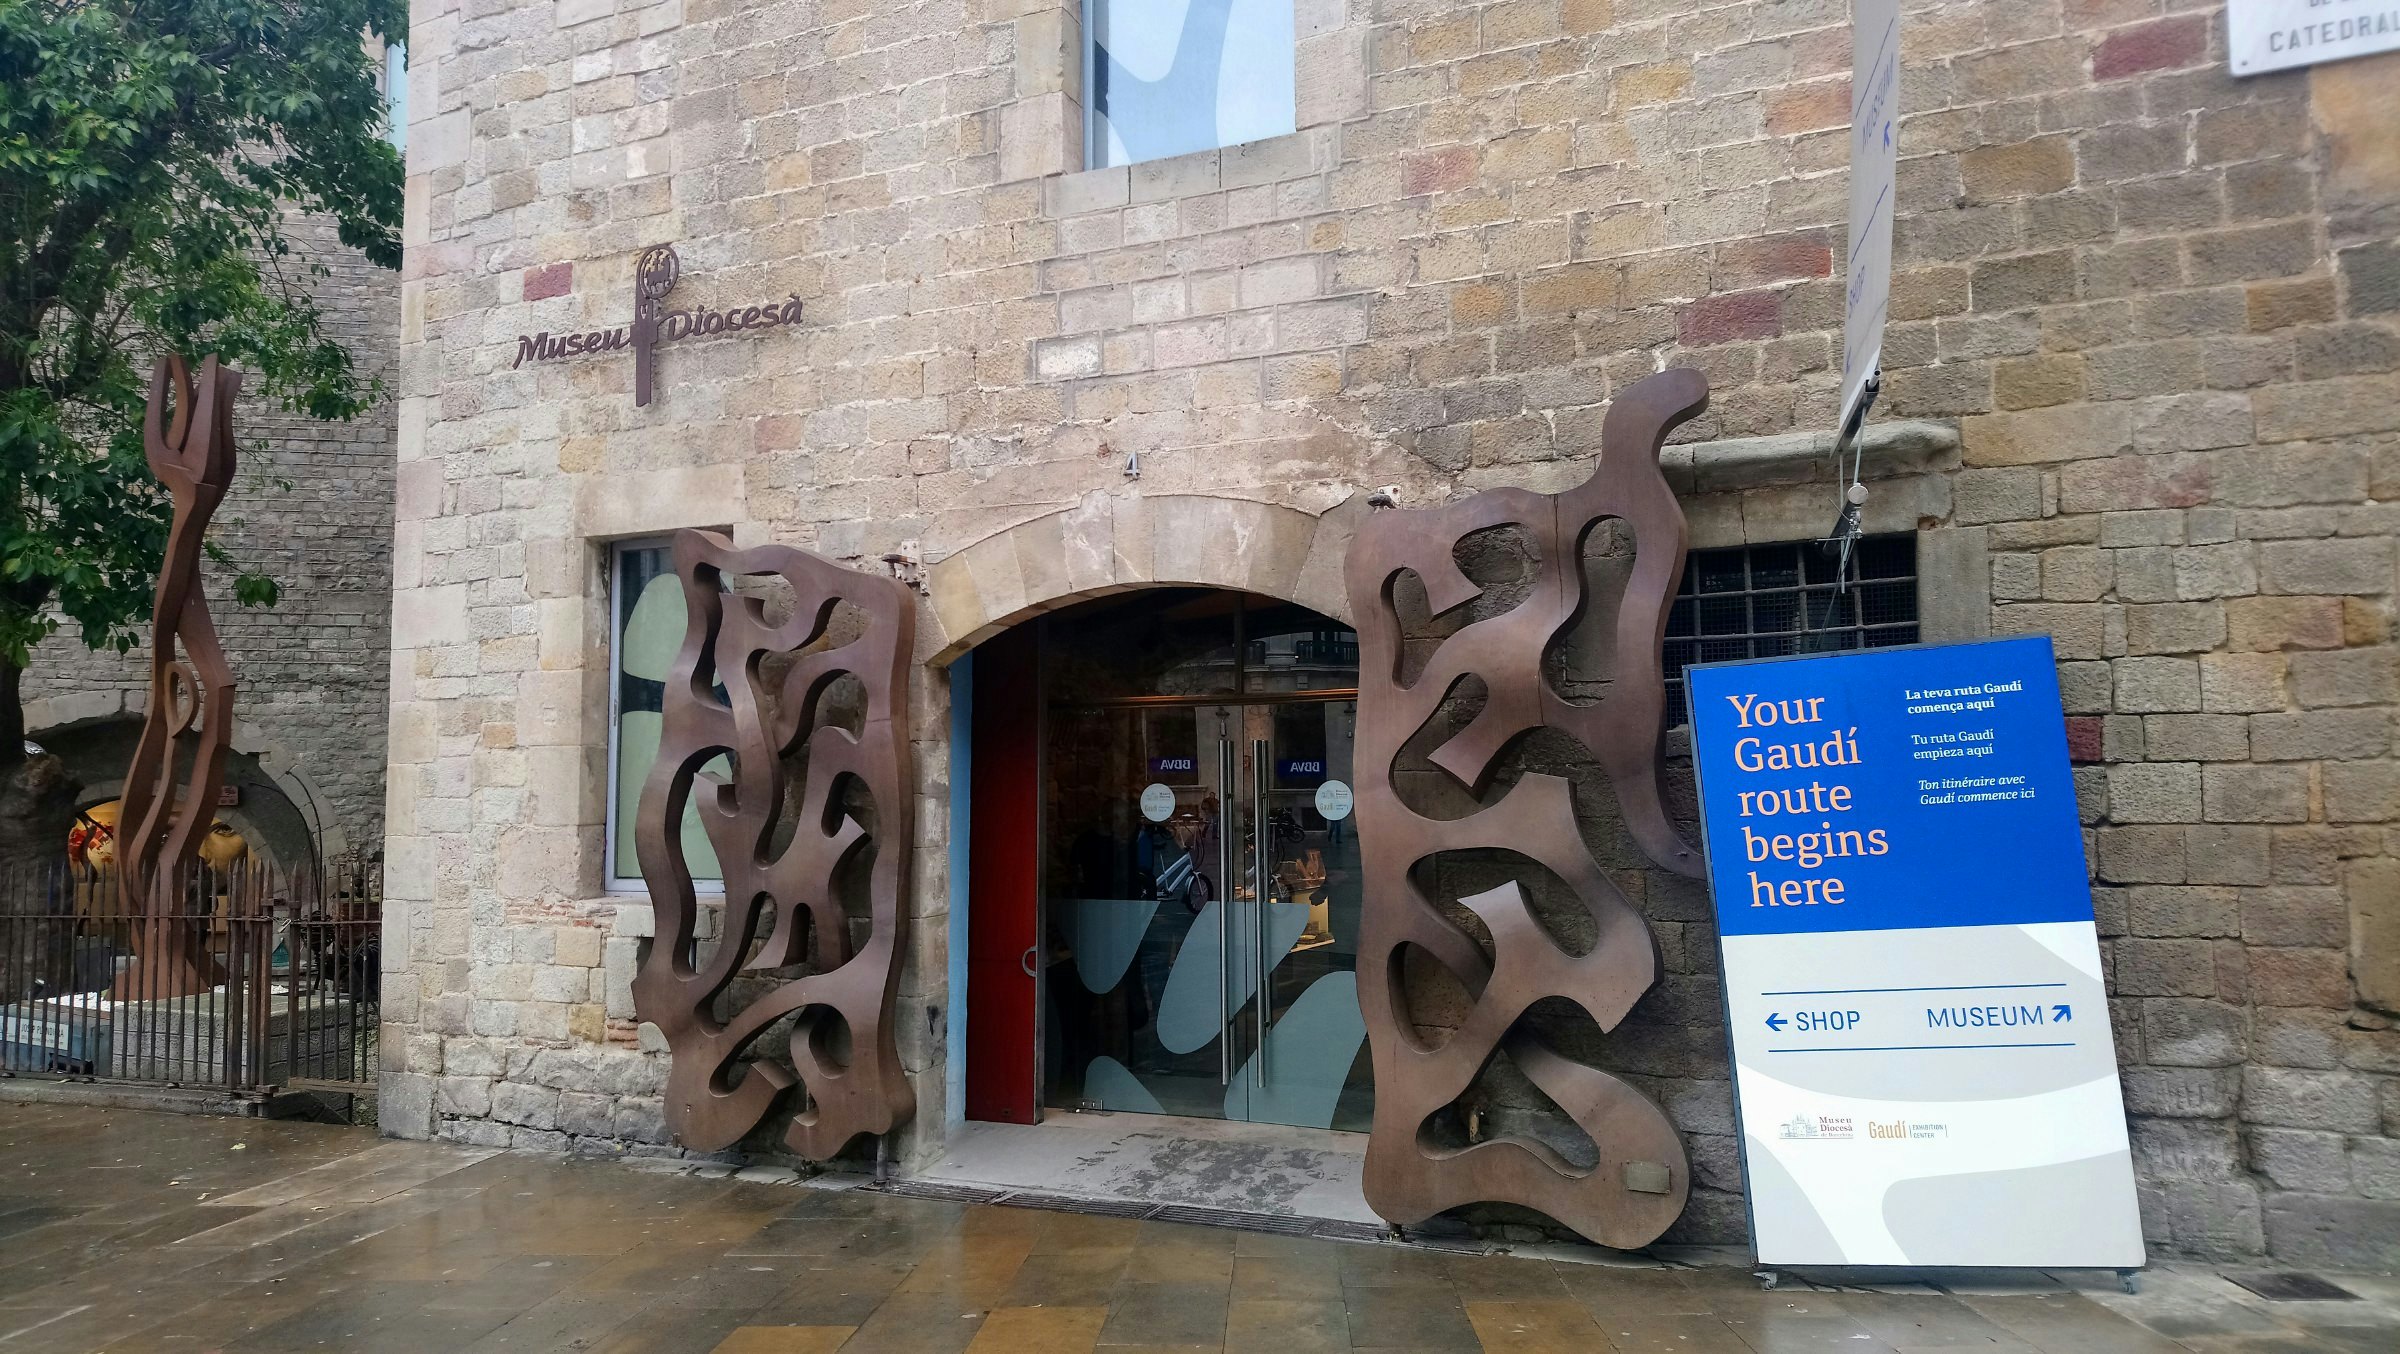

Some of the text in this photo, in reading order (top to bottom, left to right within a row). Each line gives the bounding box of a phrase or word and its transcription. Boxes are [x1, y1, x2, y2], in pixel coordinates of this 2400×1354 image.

[2270, 10, 2400, 52] CATEDRAL
[512, 292, 803, 370] Museu Diocesà
[1124, 451, 1140, 479] 4
[1905, 680, 2023, 700] La teva ruta Gaudí
[1726, 694, 1824, 728] Your
[1907, 697, 1995, 714] comença aquí
[1912, 729, 1994, 745] Tu ruta Gaudí
[1734, 726, 1862, 772] Gaudí
[1914, 743, 1994, 760] empieza aquí
[1919, 775, 2025, 790] Ton itinéraire avec
[1737, 781, 1852, 816] route
[1920, 788, 2036, 805] Gaudí commence ici
[1741, 821, 1889, 868] begins
[1747, 871, 1845, 907] here
[1796, 1010, 1861, 1032] SHOP
[1927, 1005, 2044, 1028] MUSEUM
[1819, 1116, 1852, 1124] Museu
[1869, 1120, 1906, 1139] Gaudí
